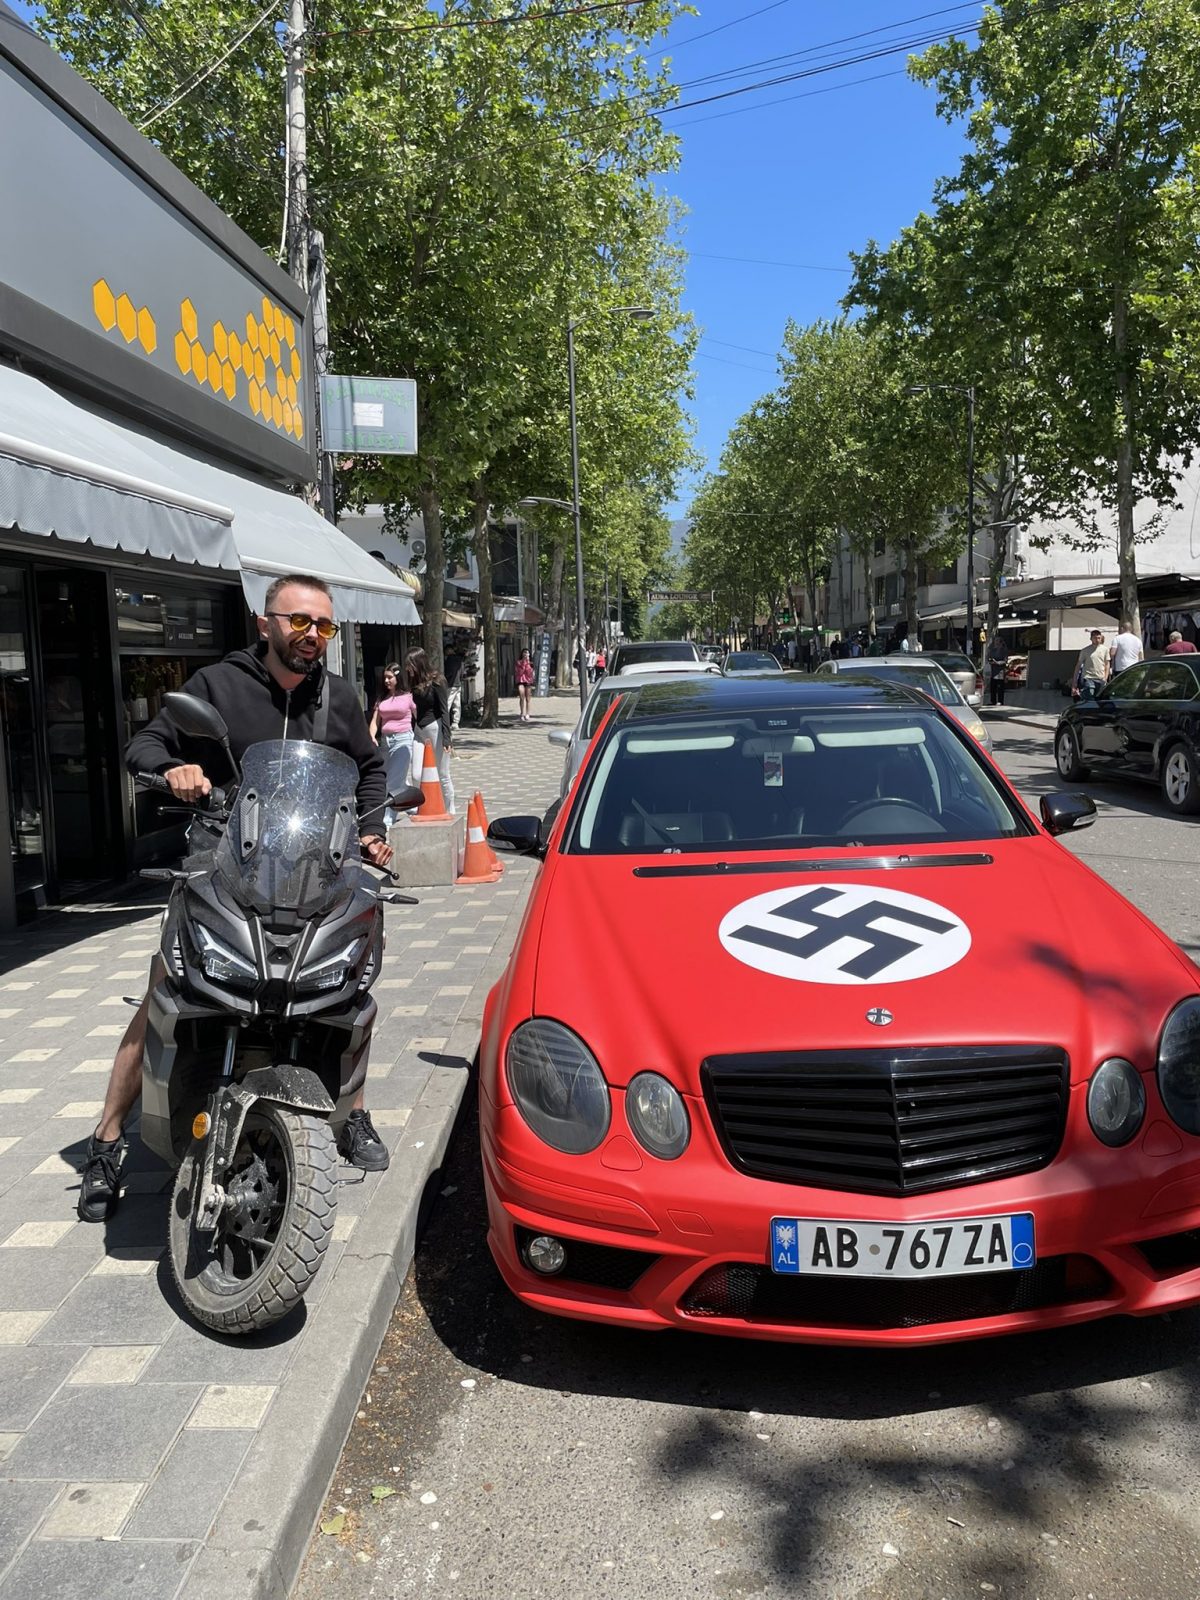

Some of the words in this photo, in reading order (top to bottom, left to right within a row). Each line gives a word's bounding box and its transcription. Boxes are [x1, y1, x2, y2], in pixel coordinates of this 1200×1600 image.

[777, 1252, 796, 1264] AL
[811, 1226, 858, 1268] AB
[882, 1226, 953, 1270] 767
[963, 1222, 1008, 1266] ZA
